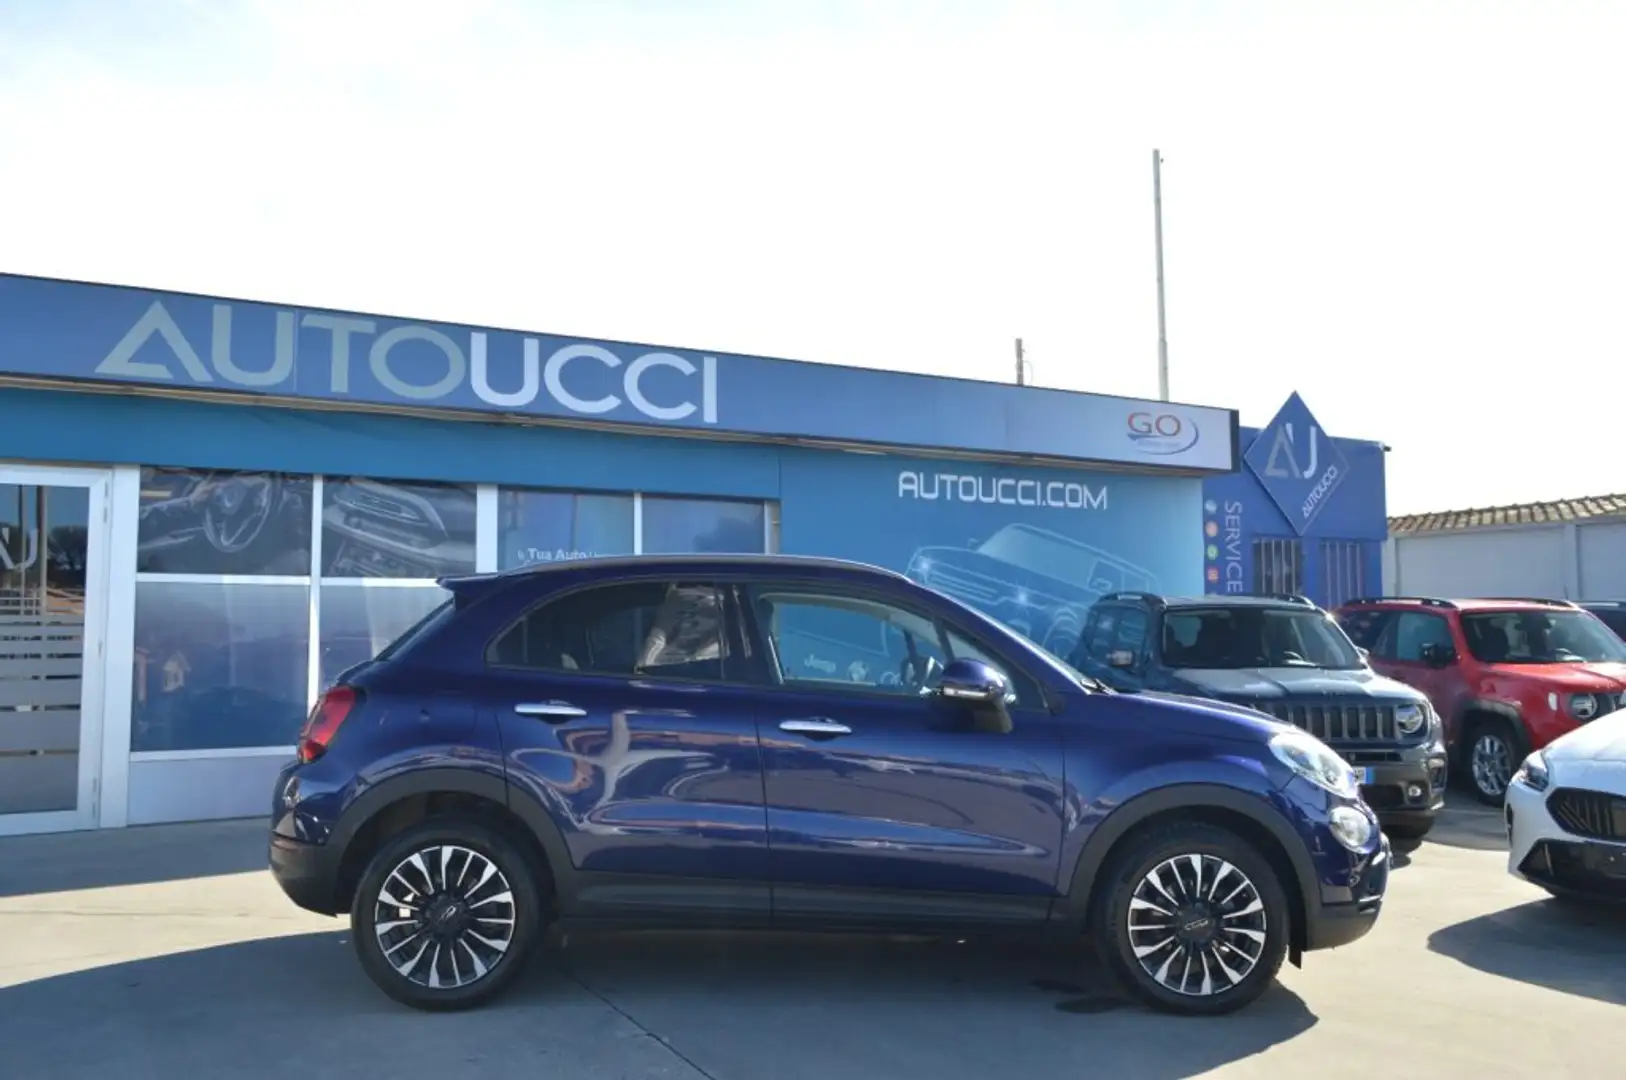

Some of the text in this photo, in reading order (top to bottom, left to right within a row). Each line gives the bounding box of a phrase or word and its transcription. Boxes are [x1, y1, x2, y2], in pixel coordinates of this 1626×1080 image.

[95, 299, 717, 424] AUTOUCCI
[1127, 412, 1181, 436] GO
[898, 471, 1108, 510] AUTOUCCI.COM
[527, 547, 552, 561] Tua
[554, 547, 588, 561] Auto
[1224, 500, 1243, 593] SERVICE
